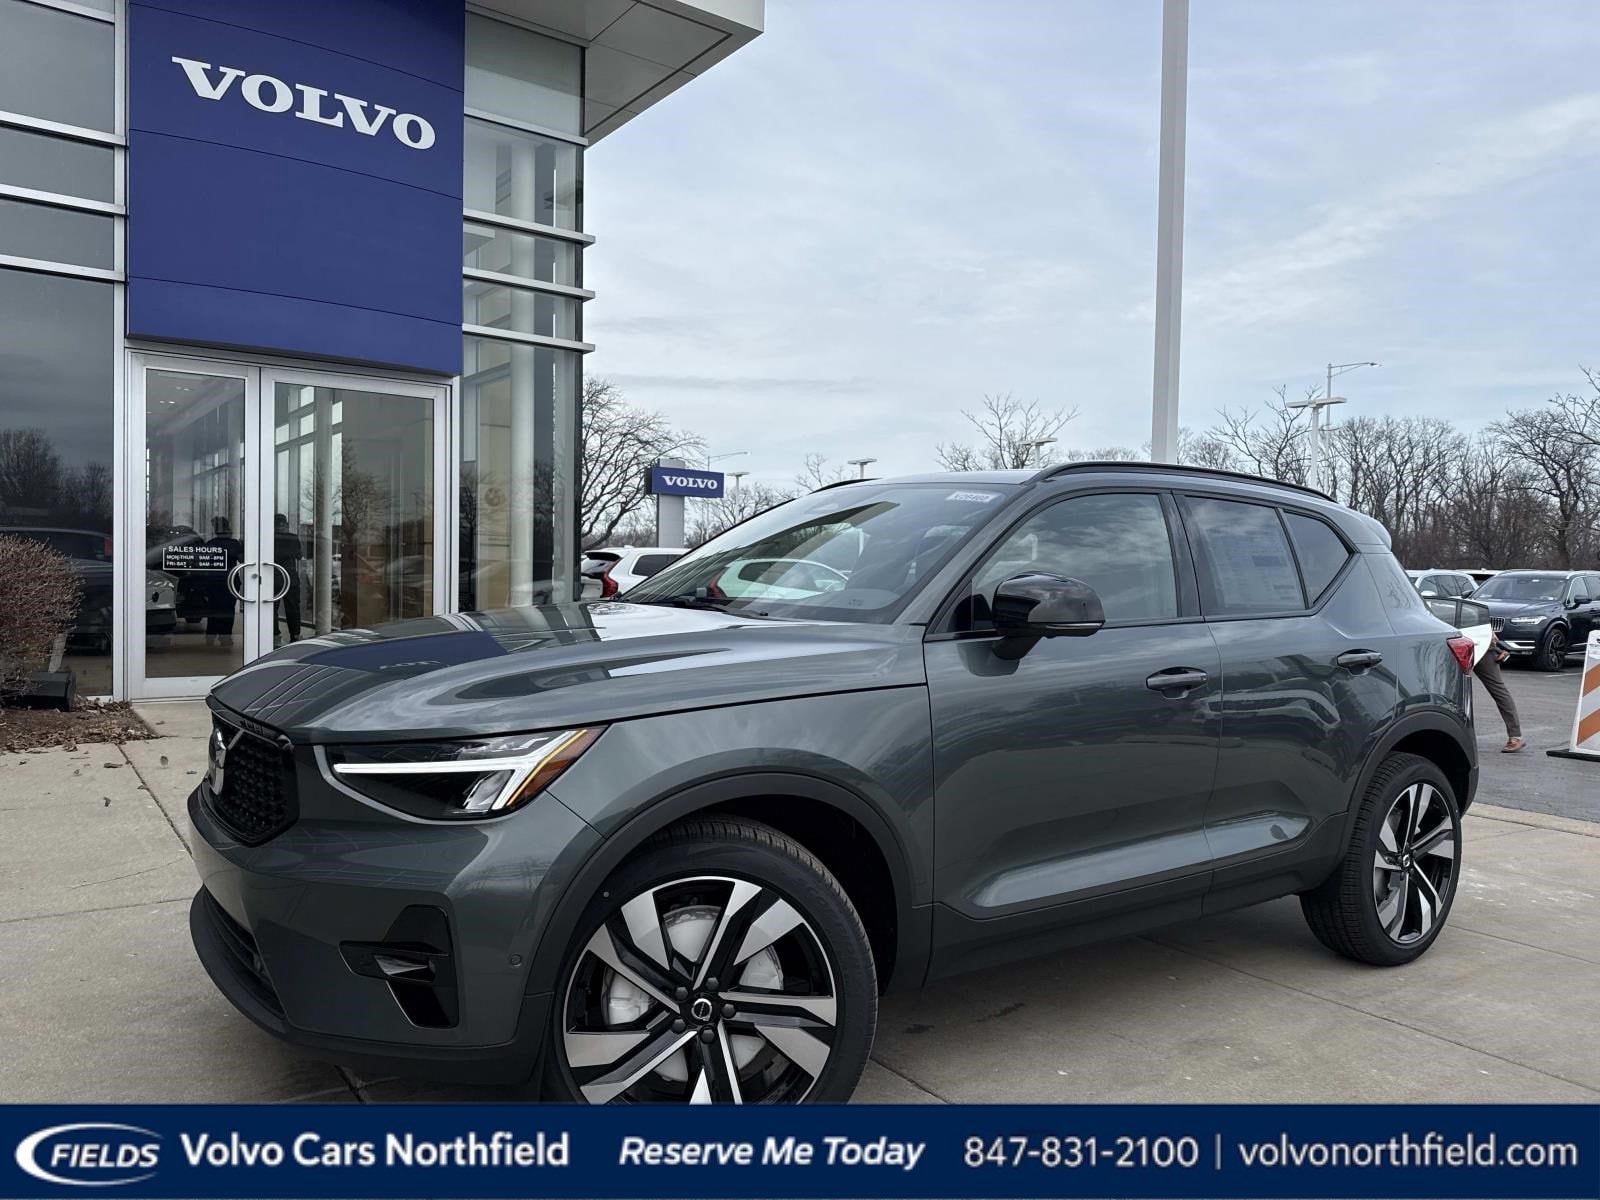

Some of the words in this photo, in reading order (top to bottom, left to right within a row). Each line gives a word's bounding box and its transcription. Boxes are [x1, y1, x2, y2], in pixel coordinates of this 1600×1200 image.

[171, 56, 436, 150] VOLVO
[662, 475, 718, 490] VOLVO
[168, 545, 194, 553] SALES
[195, 546, 223, 554] HOURS
